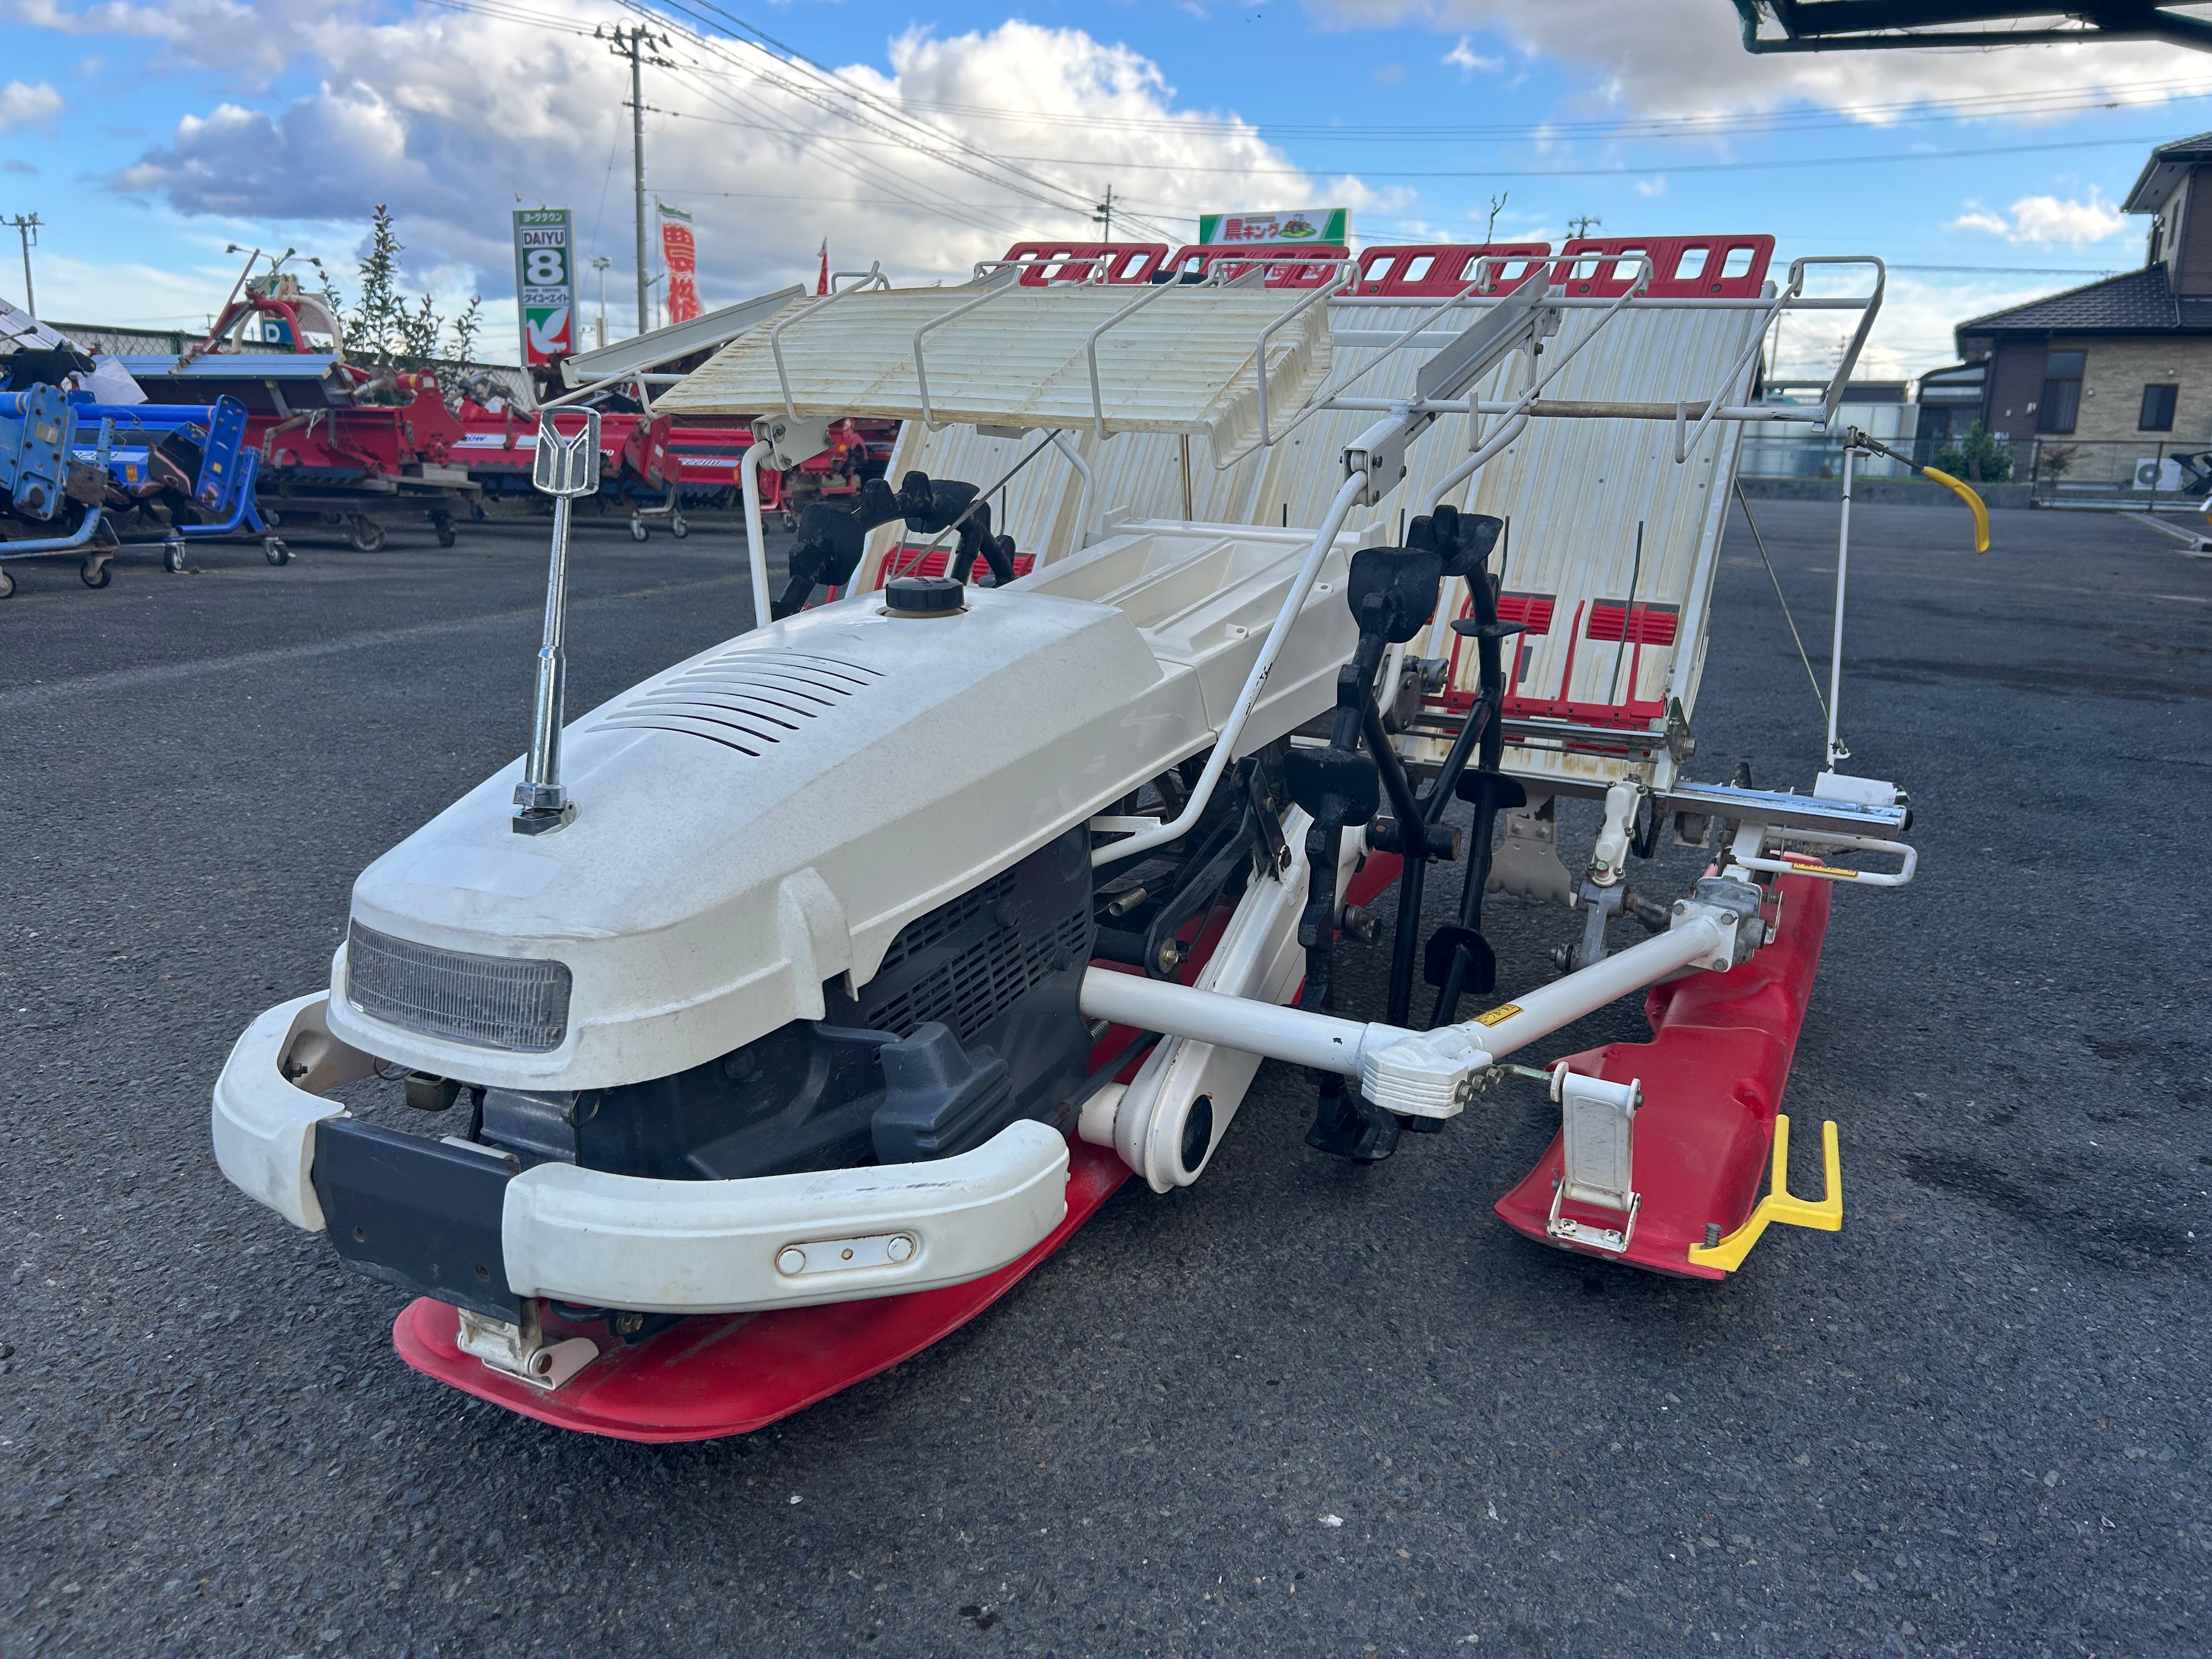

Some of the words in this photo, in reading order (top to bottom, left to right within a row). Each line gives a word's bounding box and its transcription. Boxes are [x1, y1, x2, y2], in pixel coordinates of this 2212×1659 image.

[524, 231, 564, 245] DAIYU
[1224, 218, 1280, 240] 農キング
[527, 249, 564, 285] 8
